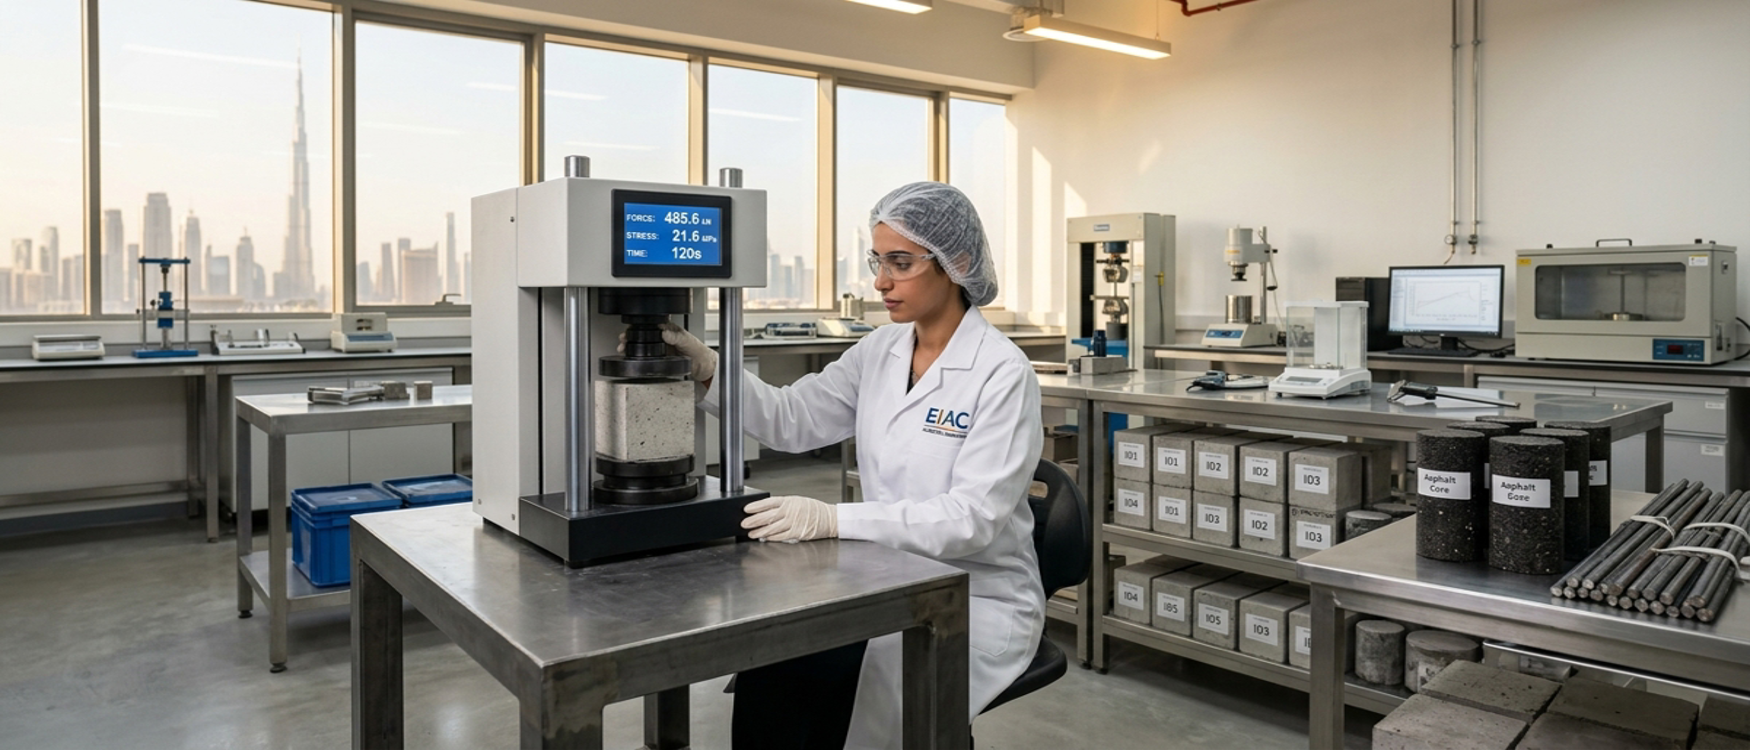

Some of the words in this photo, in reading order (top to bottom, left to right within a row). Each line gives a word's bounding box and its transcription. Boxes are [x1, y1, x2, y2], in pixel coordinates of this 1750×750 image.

[664, 211, 700, 225] 485.6
[626, 231, 660, 240] STRESS:
[671, 229, 700, 242] 21.6
[626, 249, 648, 257] TIME:
[671, 246, 702, 260] 120s
[925, 407, 970, 430] EIAC
[1424, 473, 1457, 484] Asphalt
[1501, 481, 1536, 492] Asphalt
